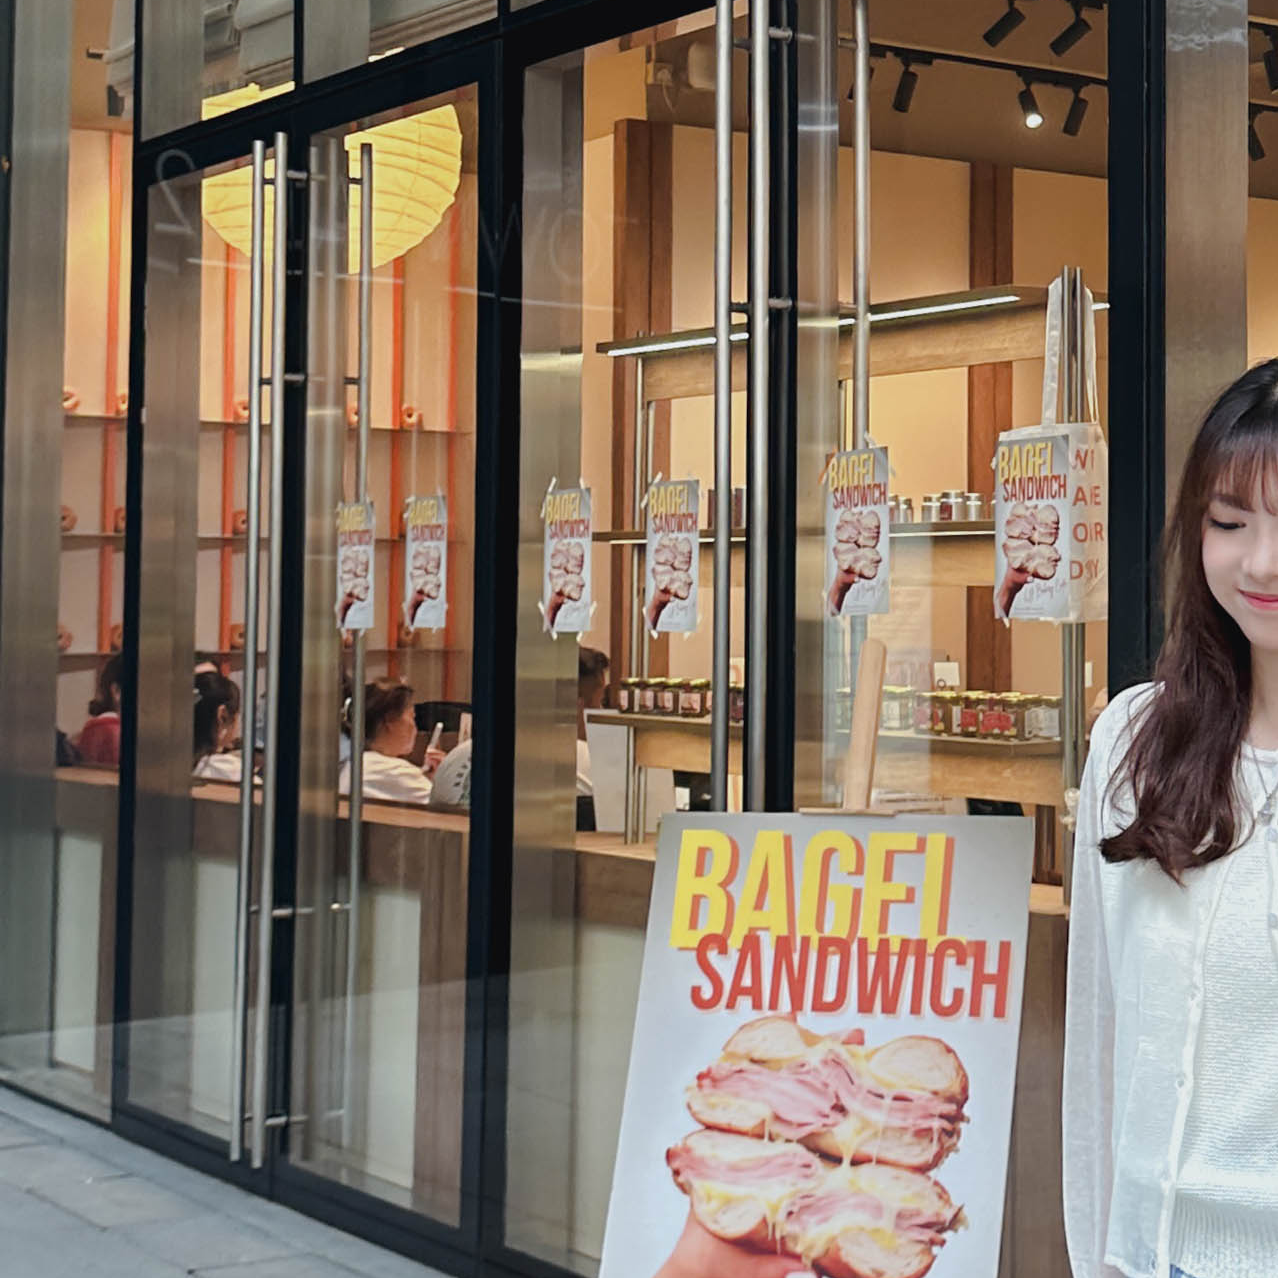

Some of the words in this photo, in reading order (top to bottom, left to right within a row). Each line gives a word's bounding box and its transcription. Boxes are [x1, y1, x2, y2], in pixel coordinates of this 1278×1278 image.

[833, 481, 888, 510] SANDWICH
[1003, 474, 1067, 503] SANDWICH
[549, 519, 590, 539] SANDWICH
[652, 512, 698, 535] SANDWICH
[669, 829, 968, 952] BAGEL
[690, 933, 1013, 1019] SANDWICH
